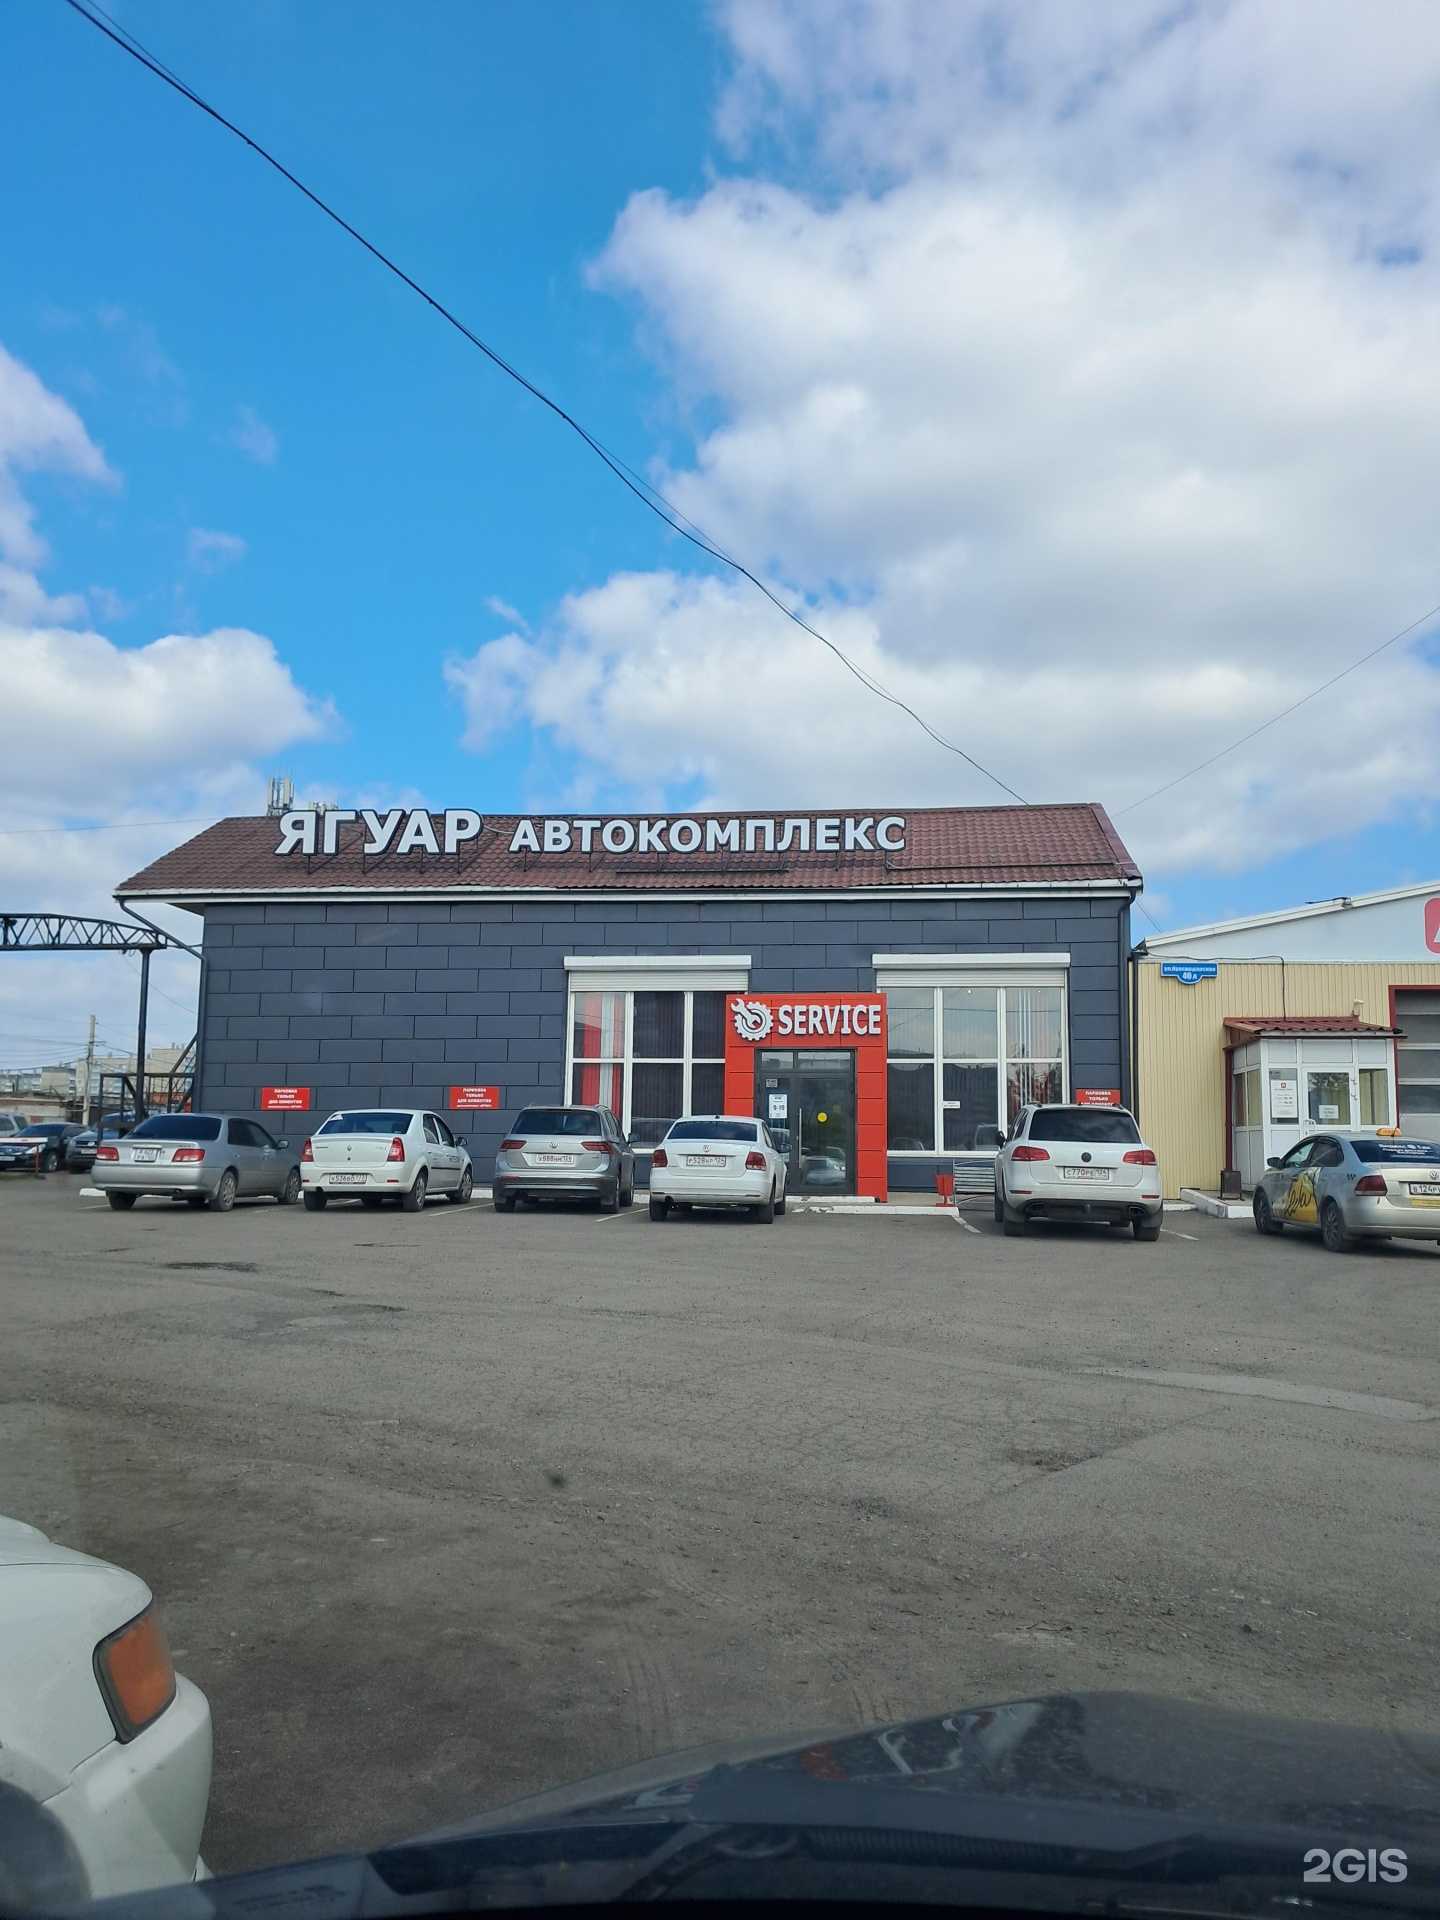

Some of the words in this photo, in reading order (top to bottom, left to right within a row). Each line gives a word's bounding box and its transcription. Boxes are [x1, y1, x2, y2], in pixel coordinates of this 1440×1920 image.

[274, 808, 483, 855] ЯГУАР
[508, 816, 906, 854] АВТОКОМПЛЕКС
[778, 1004, 881, 1036] SERVICE
